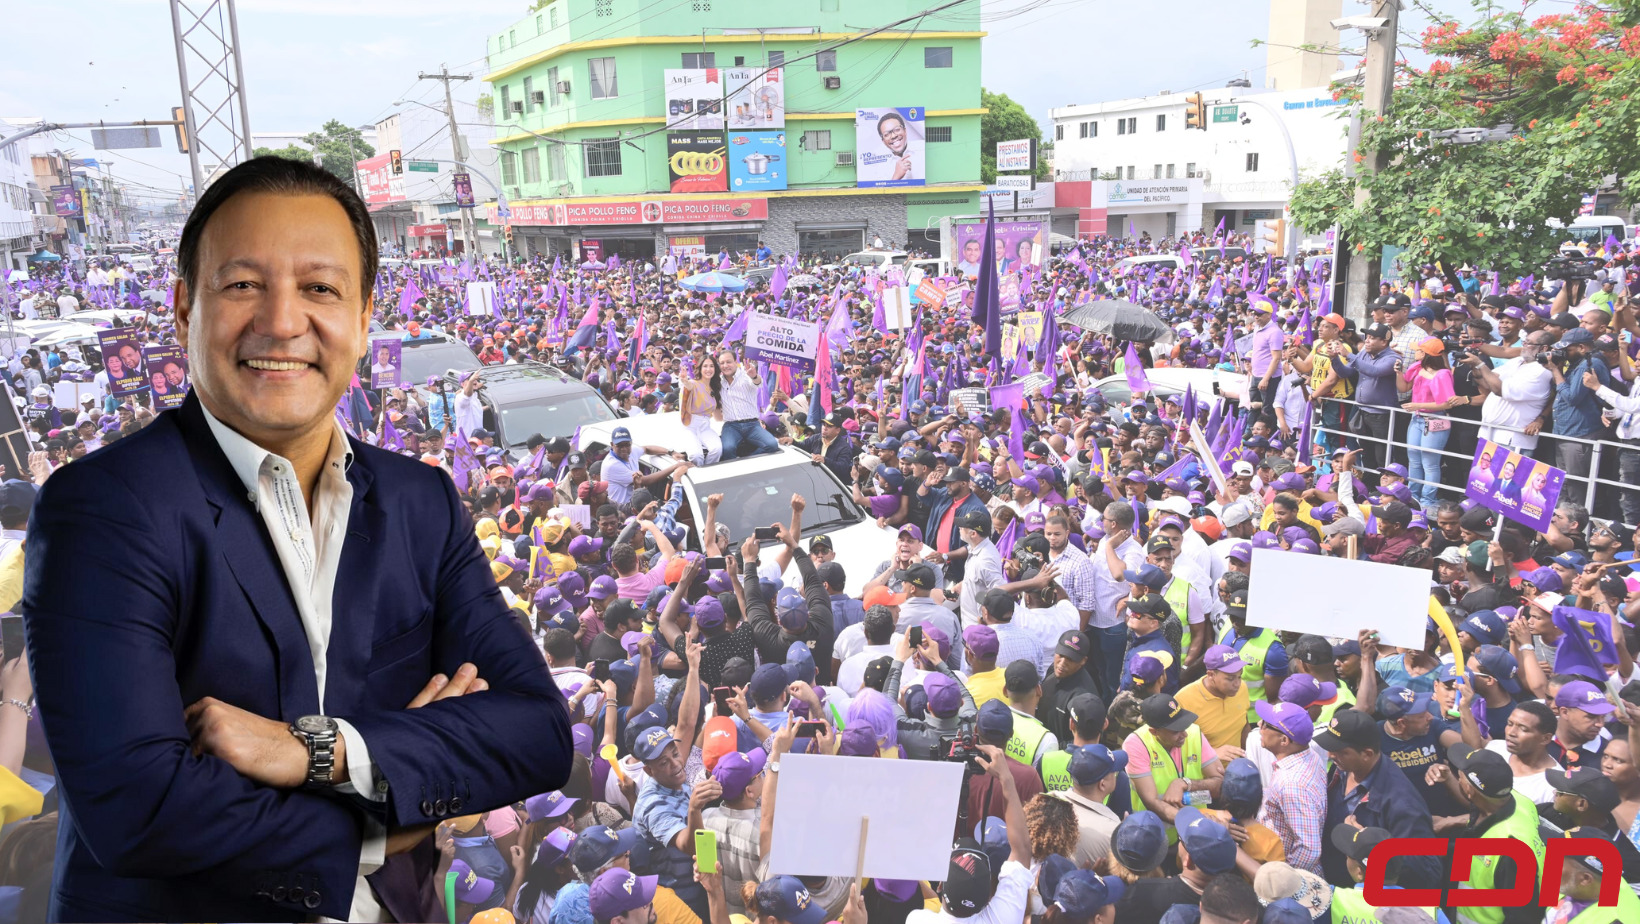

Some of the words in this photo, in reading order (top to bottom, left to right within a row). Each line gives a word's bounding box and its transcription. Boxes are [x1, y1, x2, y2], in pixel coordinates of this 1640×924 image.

[1221, 106, 1236, 115] DUARTE
[999, 143, 1028, 155] PRESTAMOS
[999, 158, 1005, 168] AL
[1005, 156, 1028, 168] INSTANTE
[997, 179, 1029, 187] BARATICOSAS
[980, 190, 1011, 198] MOTORS
[1149, 185, 1169, 193] ATENCIÓN
[1169, 185, 1188, 193] PRIMARIA
[1153, 194, 1171, 202] PACÍFICO
[516, 208, 532, 220] POLLO
[534, 207, 548, 219] FENG
[568, 207, 587, 216] PICA
[589, 206, 614, 215] POLLO
[616, 205, 637, 215] FENG
[664, 205, 683, 214] PICA
[685, 205, 710, 213] POLLO
[711, 204, 731, 213] FENG
[1012, 224, 1038, 232] Cristina
[675, 237, 699, 245] OFERTA
[919, 286, 942, 303] CAMPO
[757, 330, 784, 340] PRECIO
[770, 325, 794, 336] ALTO
[756, 336, 805, 353] COMIDA
[758, 350, 774, 359] Abel
[774, 353, 800, 364] Martínez
[1396, 753, 1438, 768] RESIDENTE
[1048, 774, 1071, 784] AVA
[1048, 783, 1071, 791] SEG
